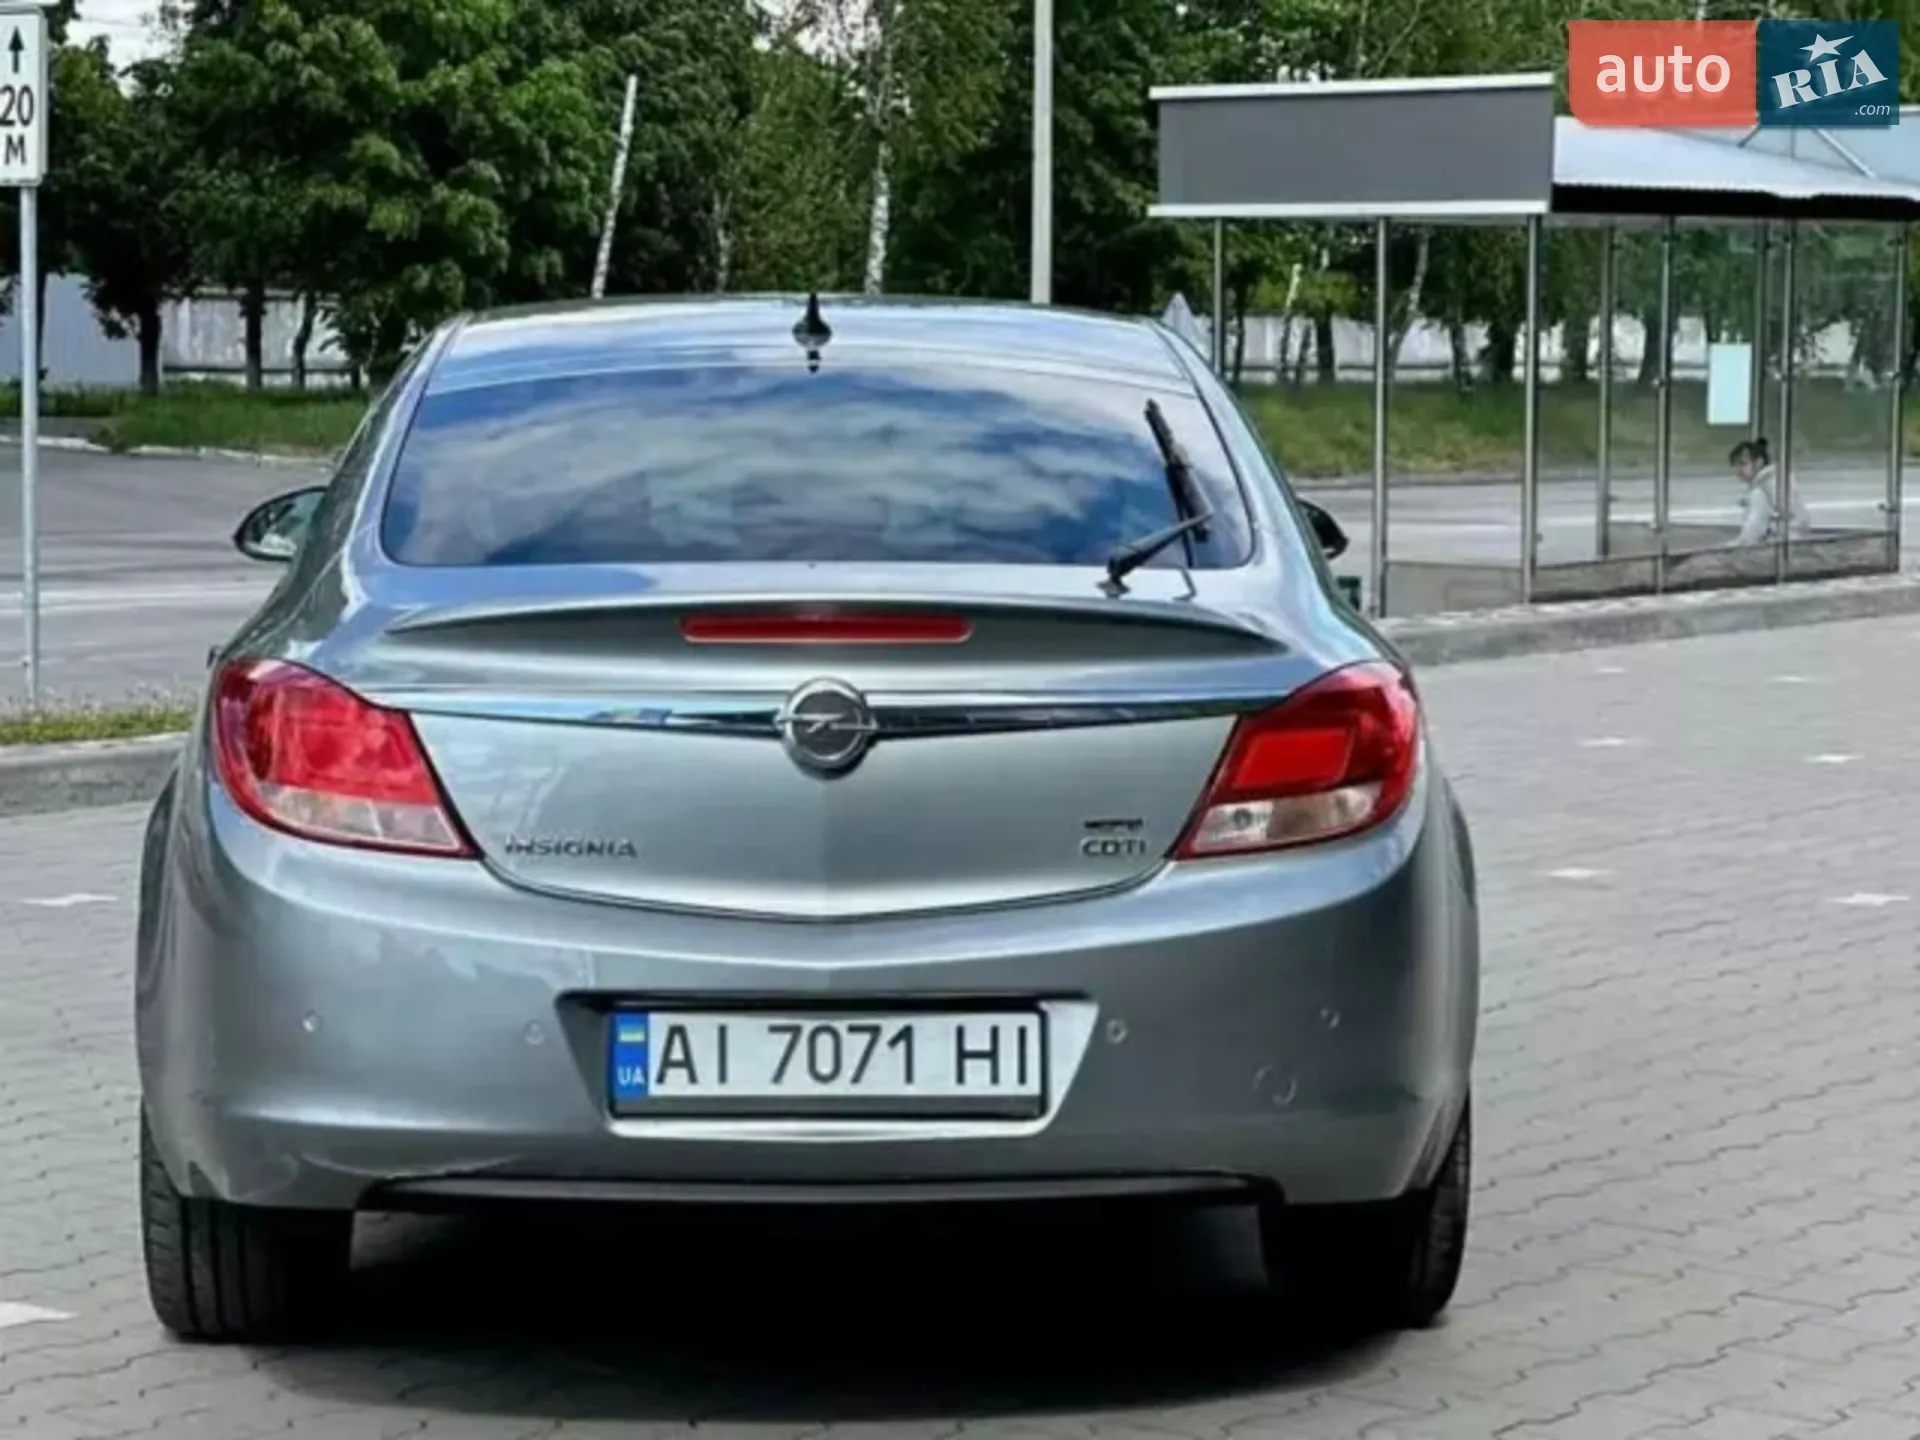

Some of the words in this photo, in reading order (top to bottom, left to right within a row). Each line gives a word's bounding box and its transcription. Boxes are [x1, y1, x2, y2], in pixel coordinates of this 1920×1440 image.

[0, 84, 34, 126] 20
[504, 836, 637, 857] INSIGNIA
[656, 1024, 728, 1085] AI
[768, 1024, 914, 1085] 7071
[955, 1024, 1027, 1086] HI
[617, 1067, 645, 1086] UA
